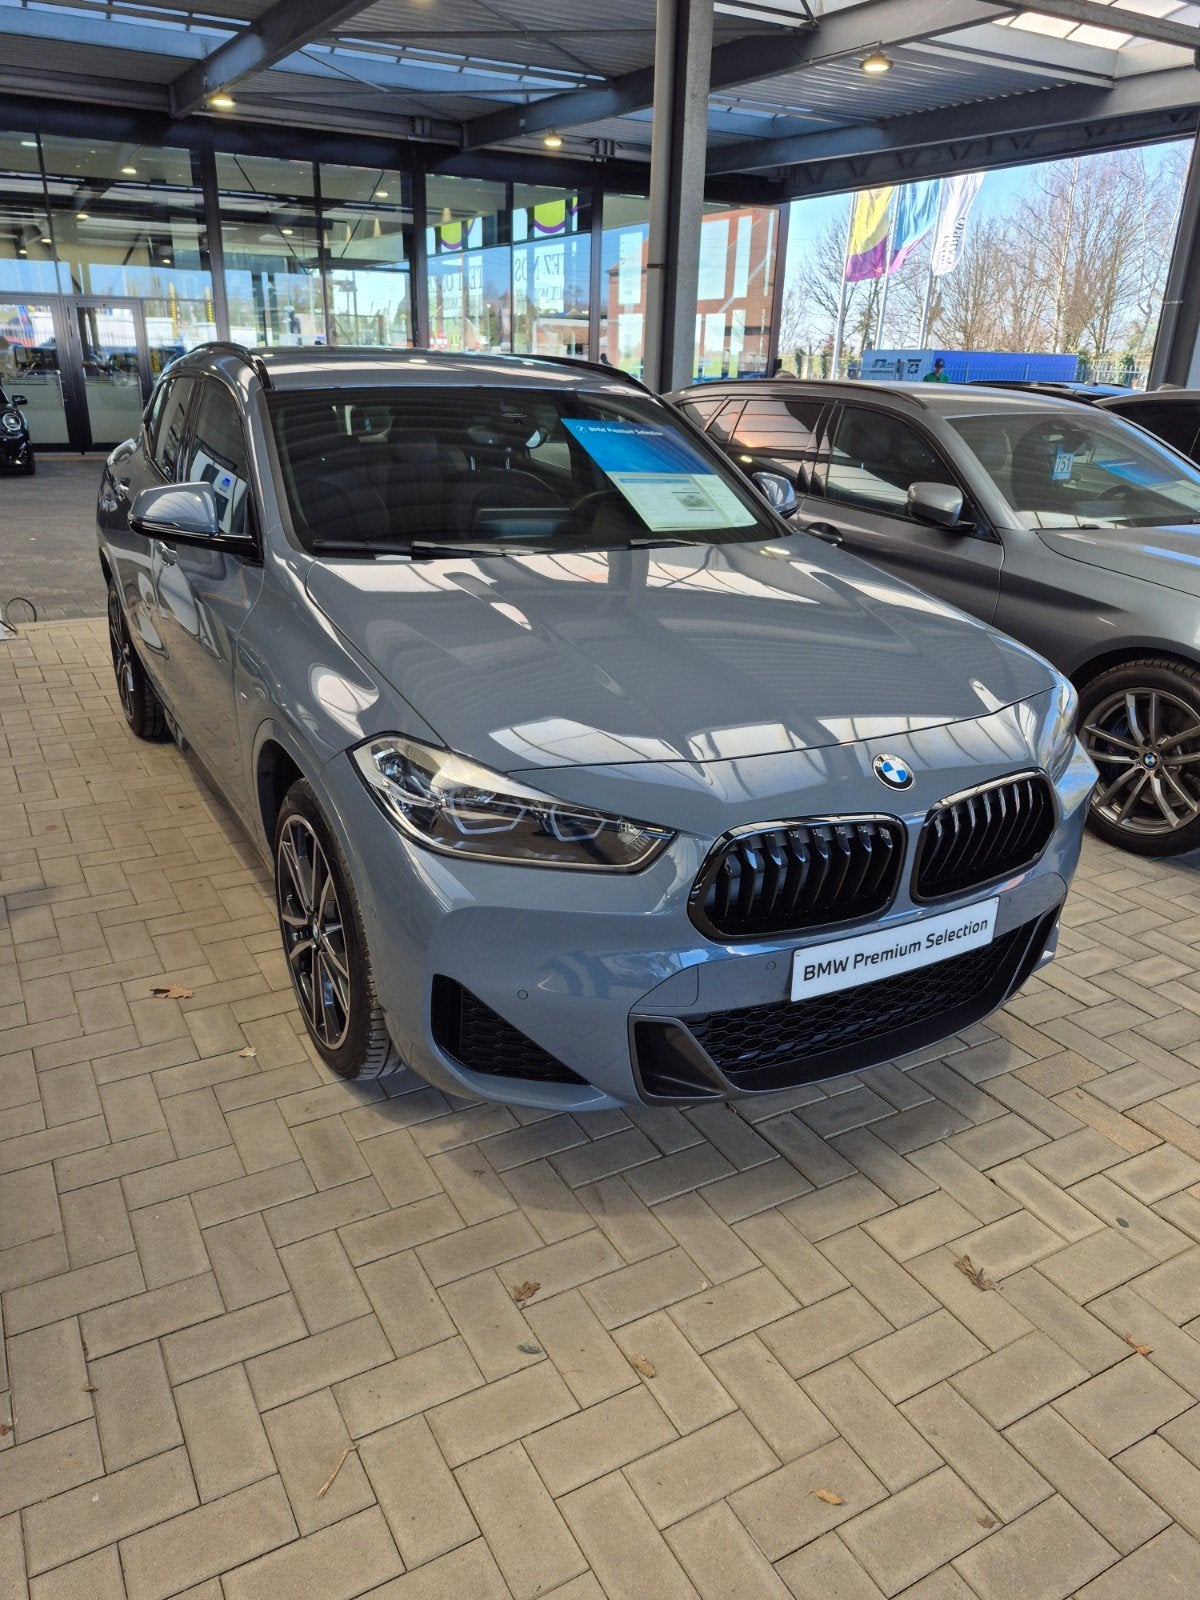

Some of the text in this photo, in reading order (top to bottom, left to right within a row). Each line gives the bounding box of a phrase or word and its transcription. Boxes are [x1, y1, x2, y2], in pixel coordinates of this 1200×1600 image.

[588, 425, 607, 433] BMW
[607, 427, 635, 435] Premium
[802, 918, 989, 982] BMW Premium Selection
